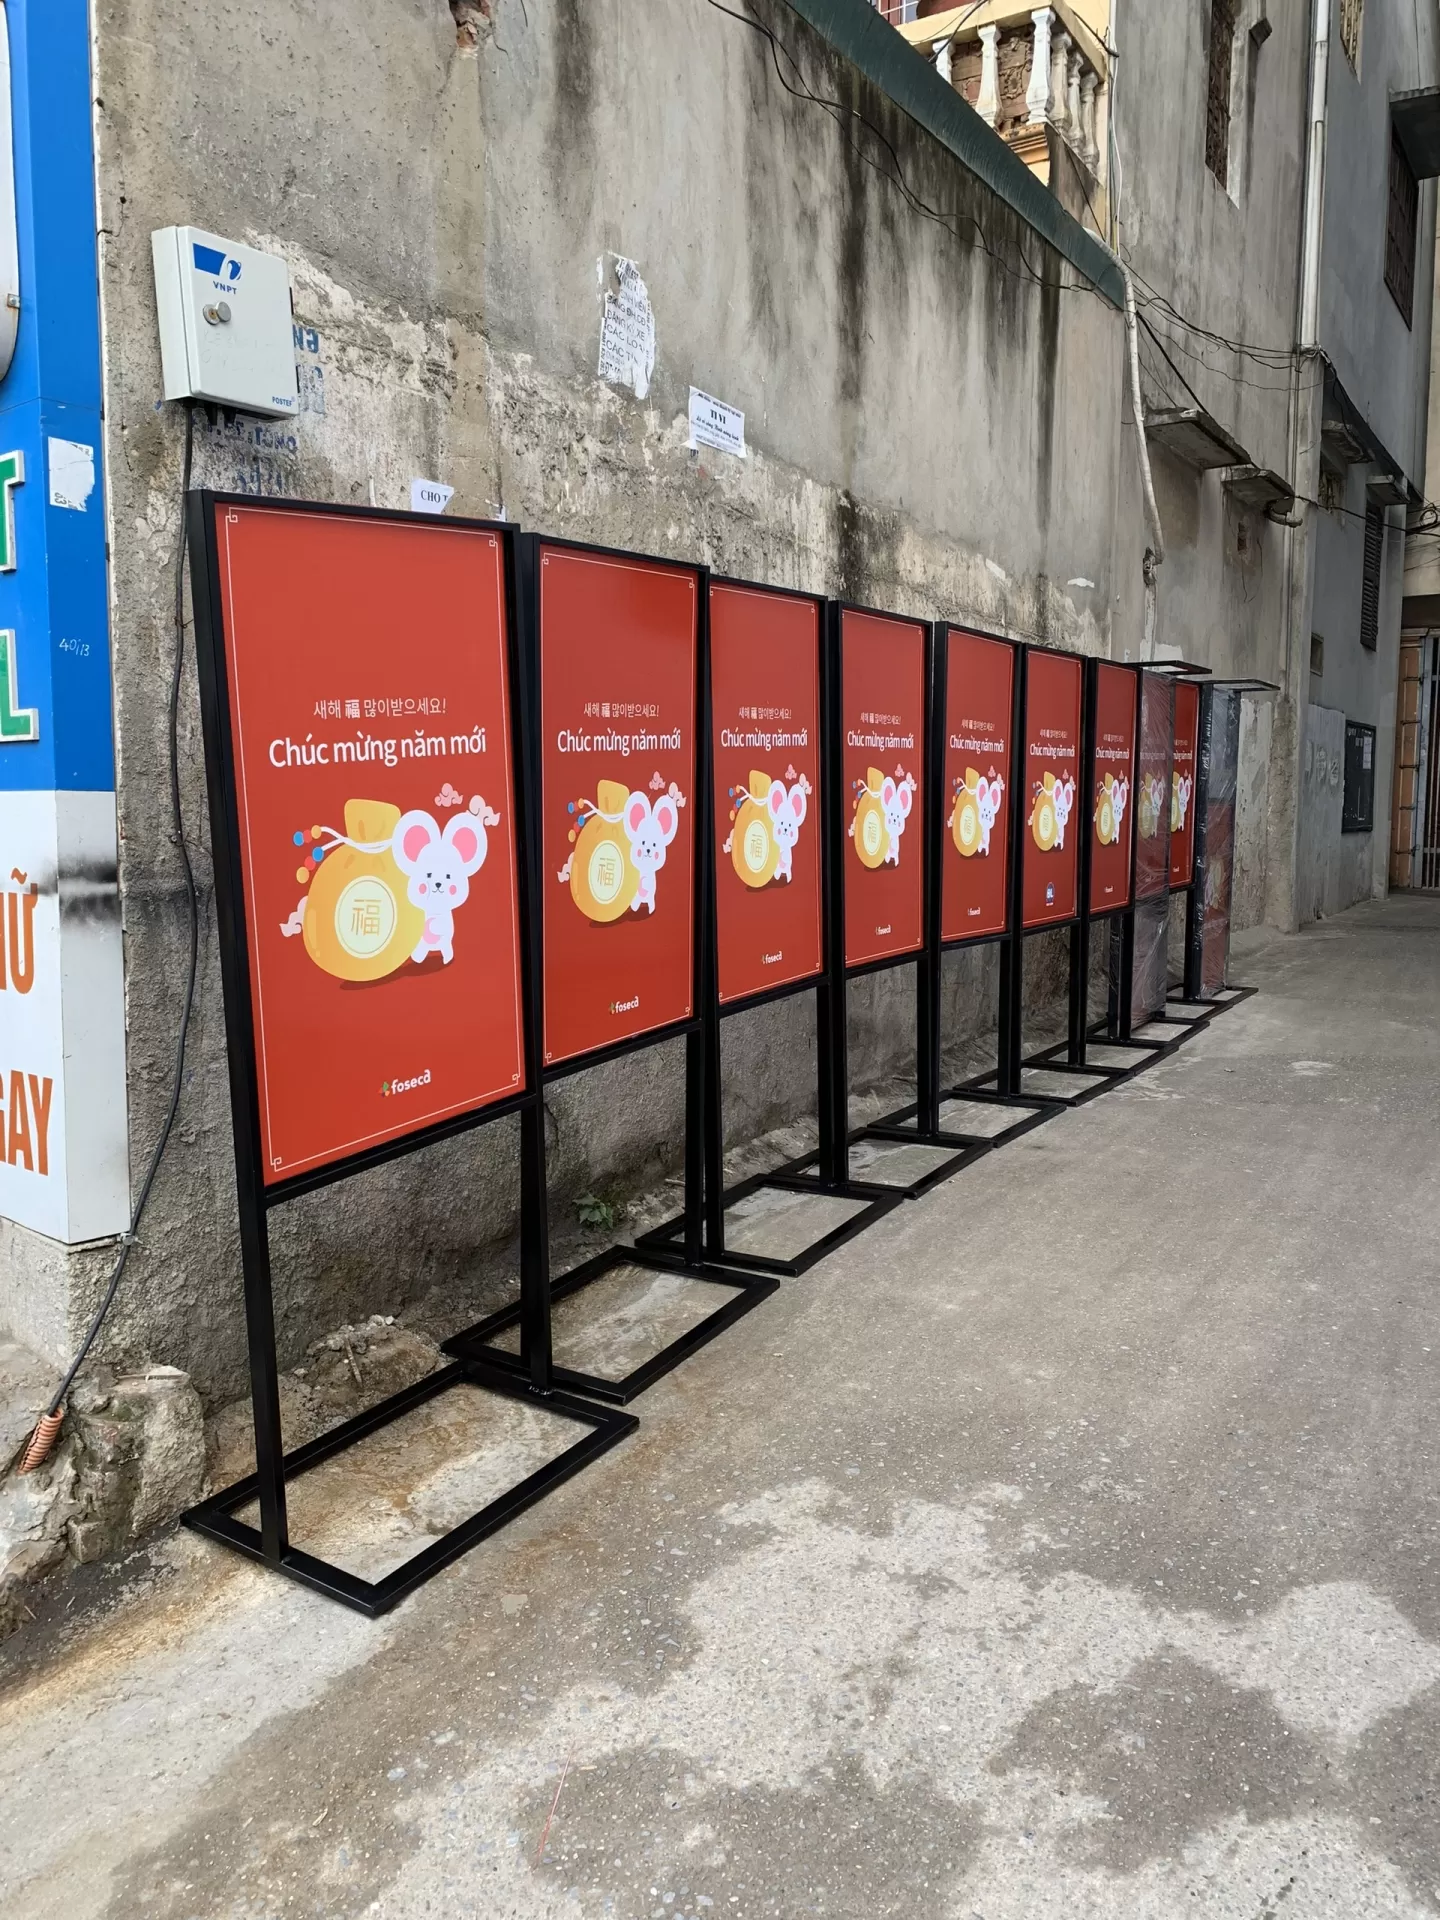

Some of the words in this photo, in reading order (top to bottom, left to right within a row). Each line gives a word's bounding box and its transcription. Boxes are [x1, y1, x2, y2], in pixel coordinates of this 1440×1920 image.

[213, 281, 237, 295] VNPT
[421, 489, 441, 503] CHO
[313, 699, 341, 720] 새해
[345, 698, 361, 719] 福
[583, 702, 600, 718] 새해
[269, 733, 329, 768] Chúc
[333, 730, 398, 767] mừng
[401, 729, 446, 758] năm
[450, 725, 486, 754] mới
[557, 727, 591, 752] Chúc
[593, 727, 630, 756] mừng
[631, 728, 657, 751] năm
[660, 727, 681, 750] mới
[721, 726, 744, 747] Chúc
[745, 727, 771, 752] mừng
[772, 728, 791, 747] năm
[792, 727, 808, 747] mới
[847, 729, 864, 747] Chúc
[865, 730, 884, 752] mừng
[885, 732, 900, 748] năm
[901, 732, 914, 749] mới
[350, 898, 382, 937] 福
